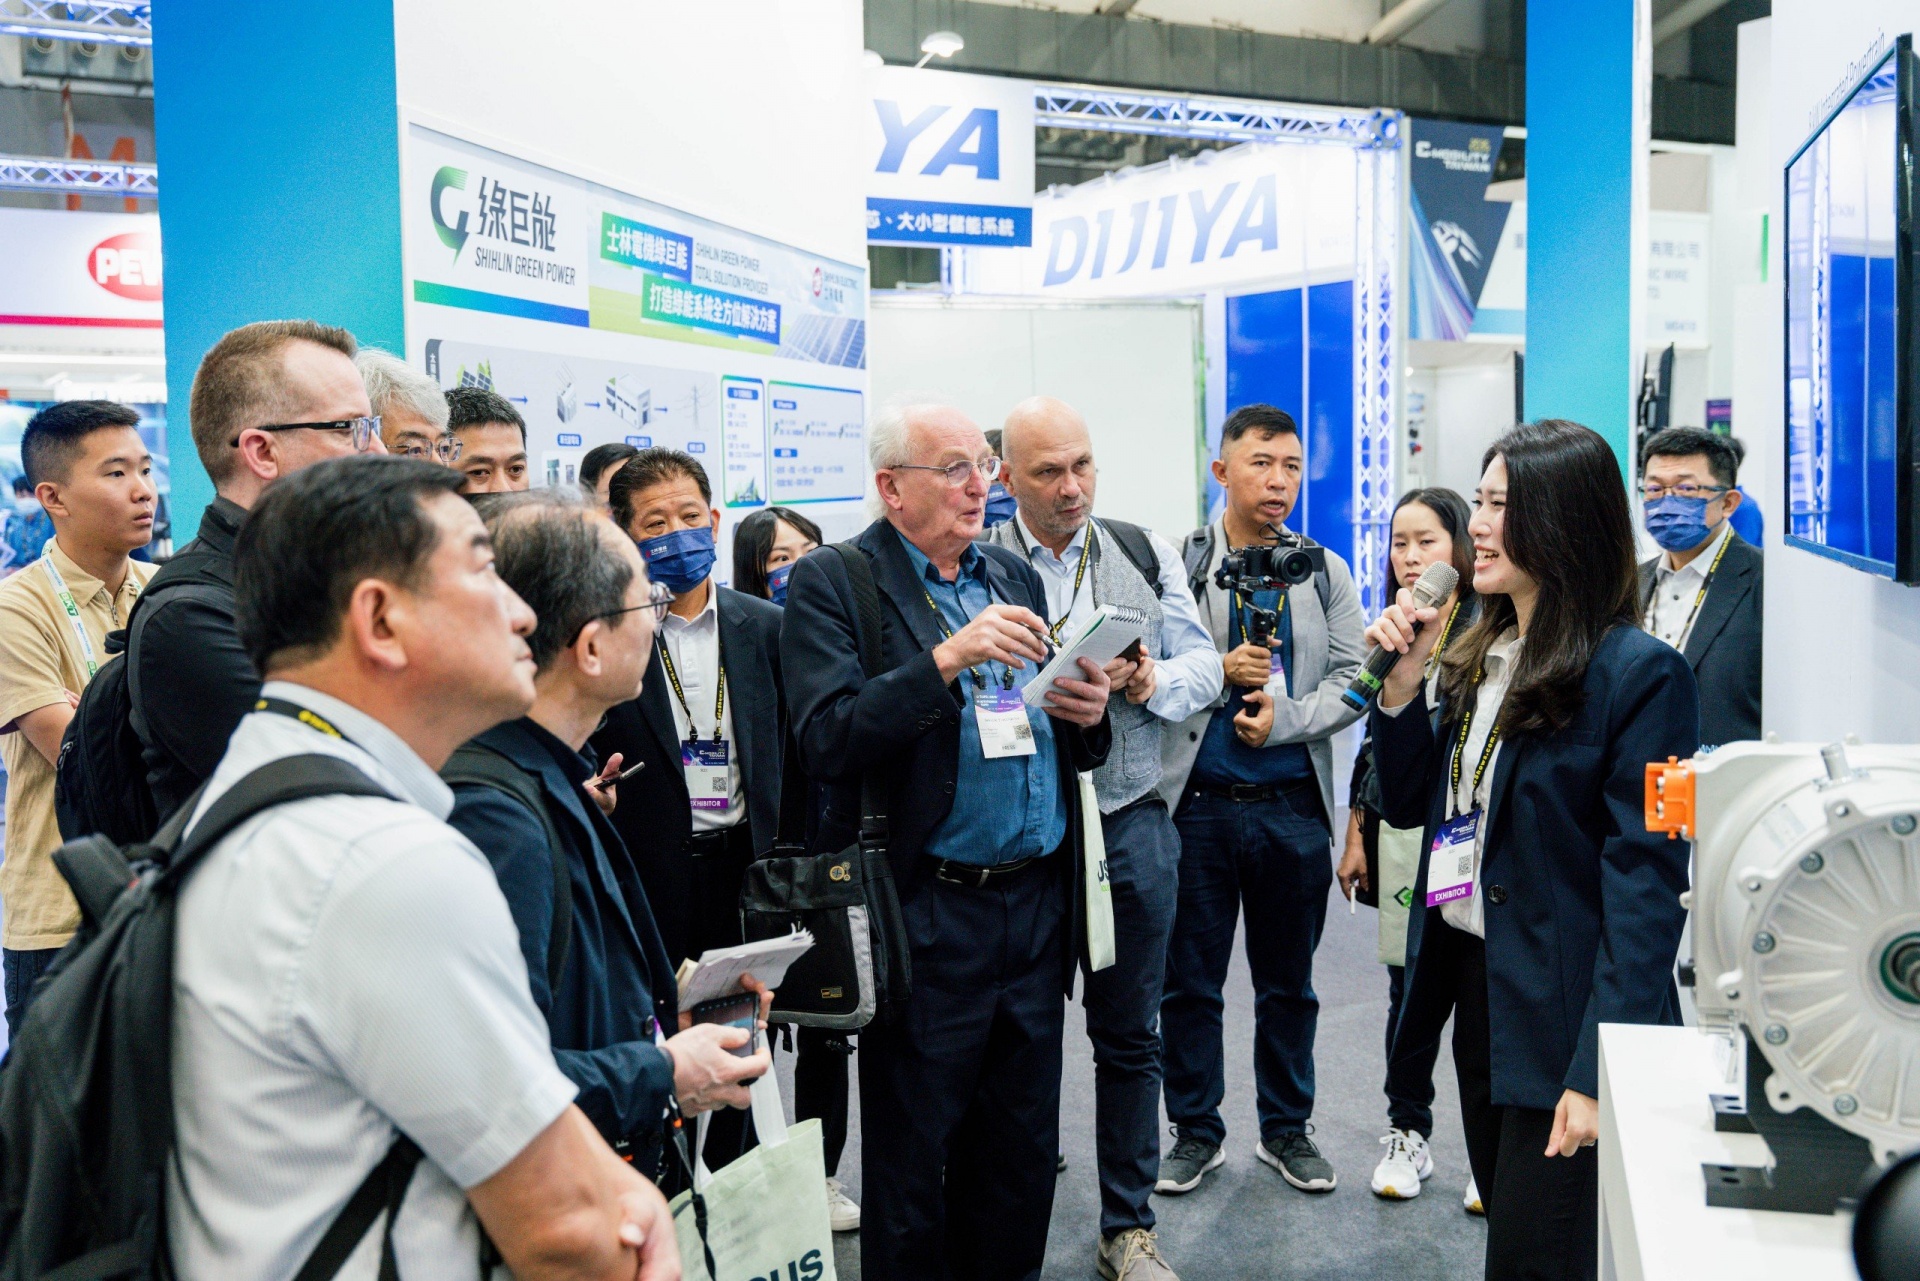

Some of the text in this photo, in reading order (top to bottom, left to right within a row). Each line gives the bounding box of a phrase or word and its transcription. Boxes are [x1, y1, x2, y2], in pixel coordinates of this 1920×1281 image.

[476, 176, 556, 252] 綠巨能
[474, 247, 576, 286] SHIHLIN GREEN POWER
[606, 223, 688, 271] 士林電機綠巨能
[1434, 887, 1466, 902] EXHIBITOR
